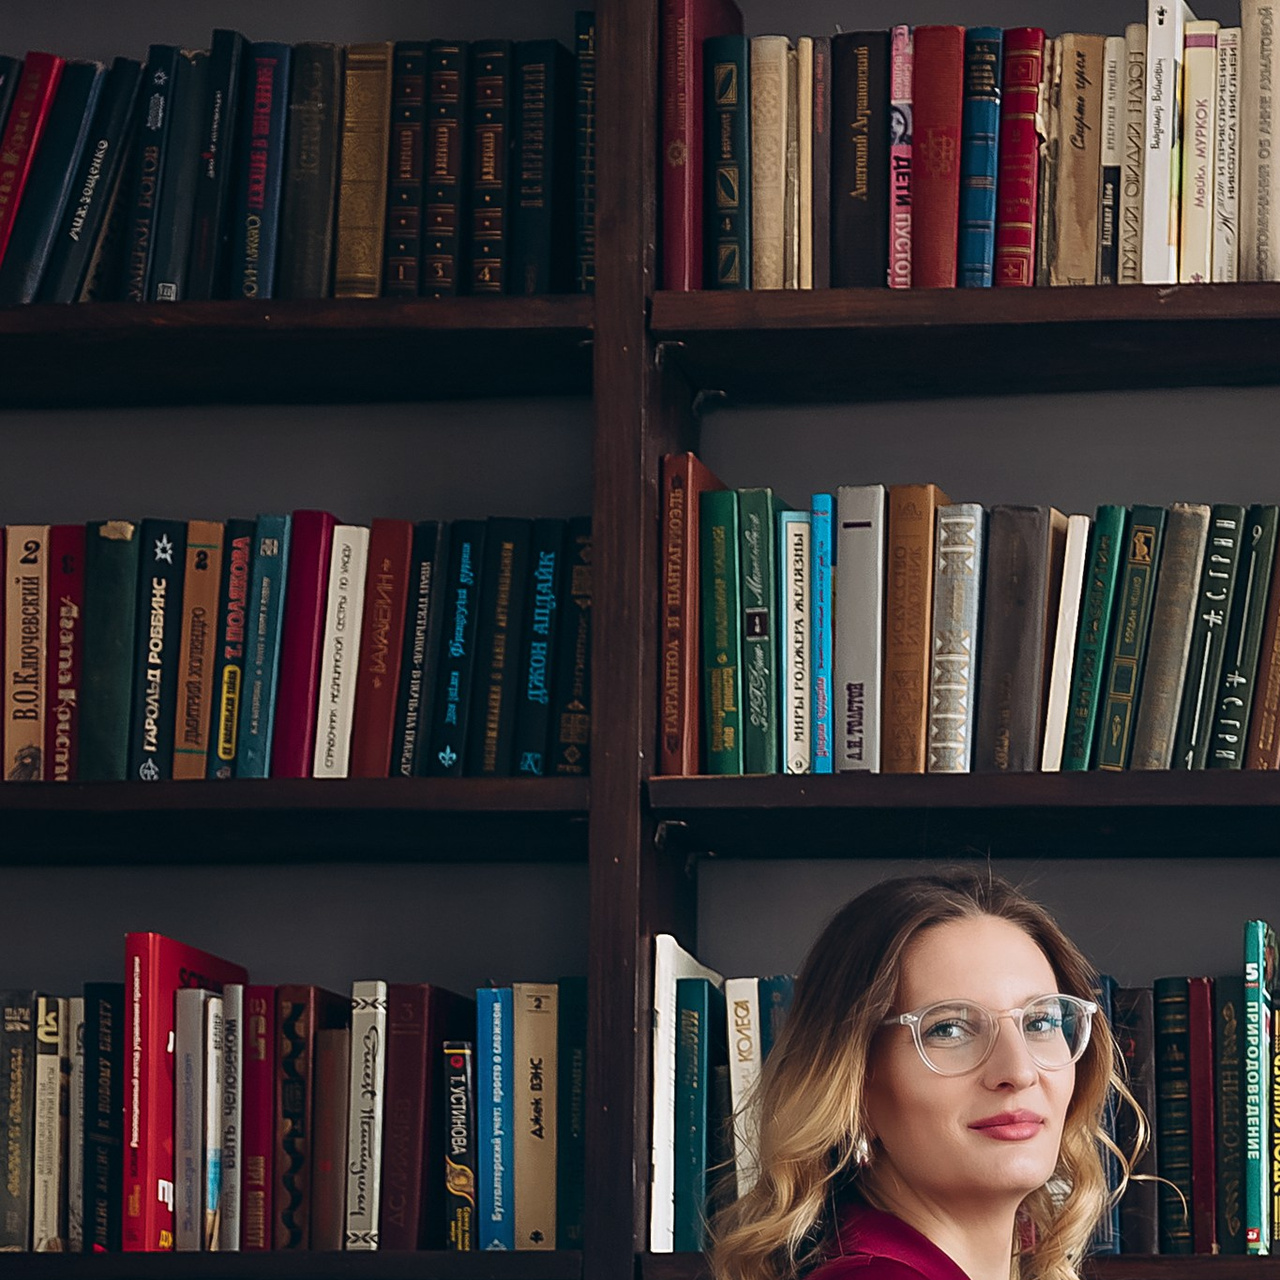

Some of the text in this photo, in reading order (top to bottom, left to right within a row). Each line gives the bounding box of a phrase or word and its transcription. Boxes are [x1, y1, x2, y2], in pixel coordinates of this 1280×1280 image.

[849, 45, 872, 201] Анатолий Аграновский
[142, 576, 168, 752] ГАРОЛЬД РОББИНС
[526, 551, 556, 705] ДЖОН АПДАЙК
[529, 1057, 545, 1140] Джек ВЭНС
